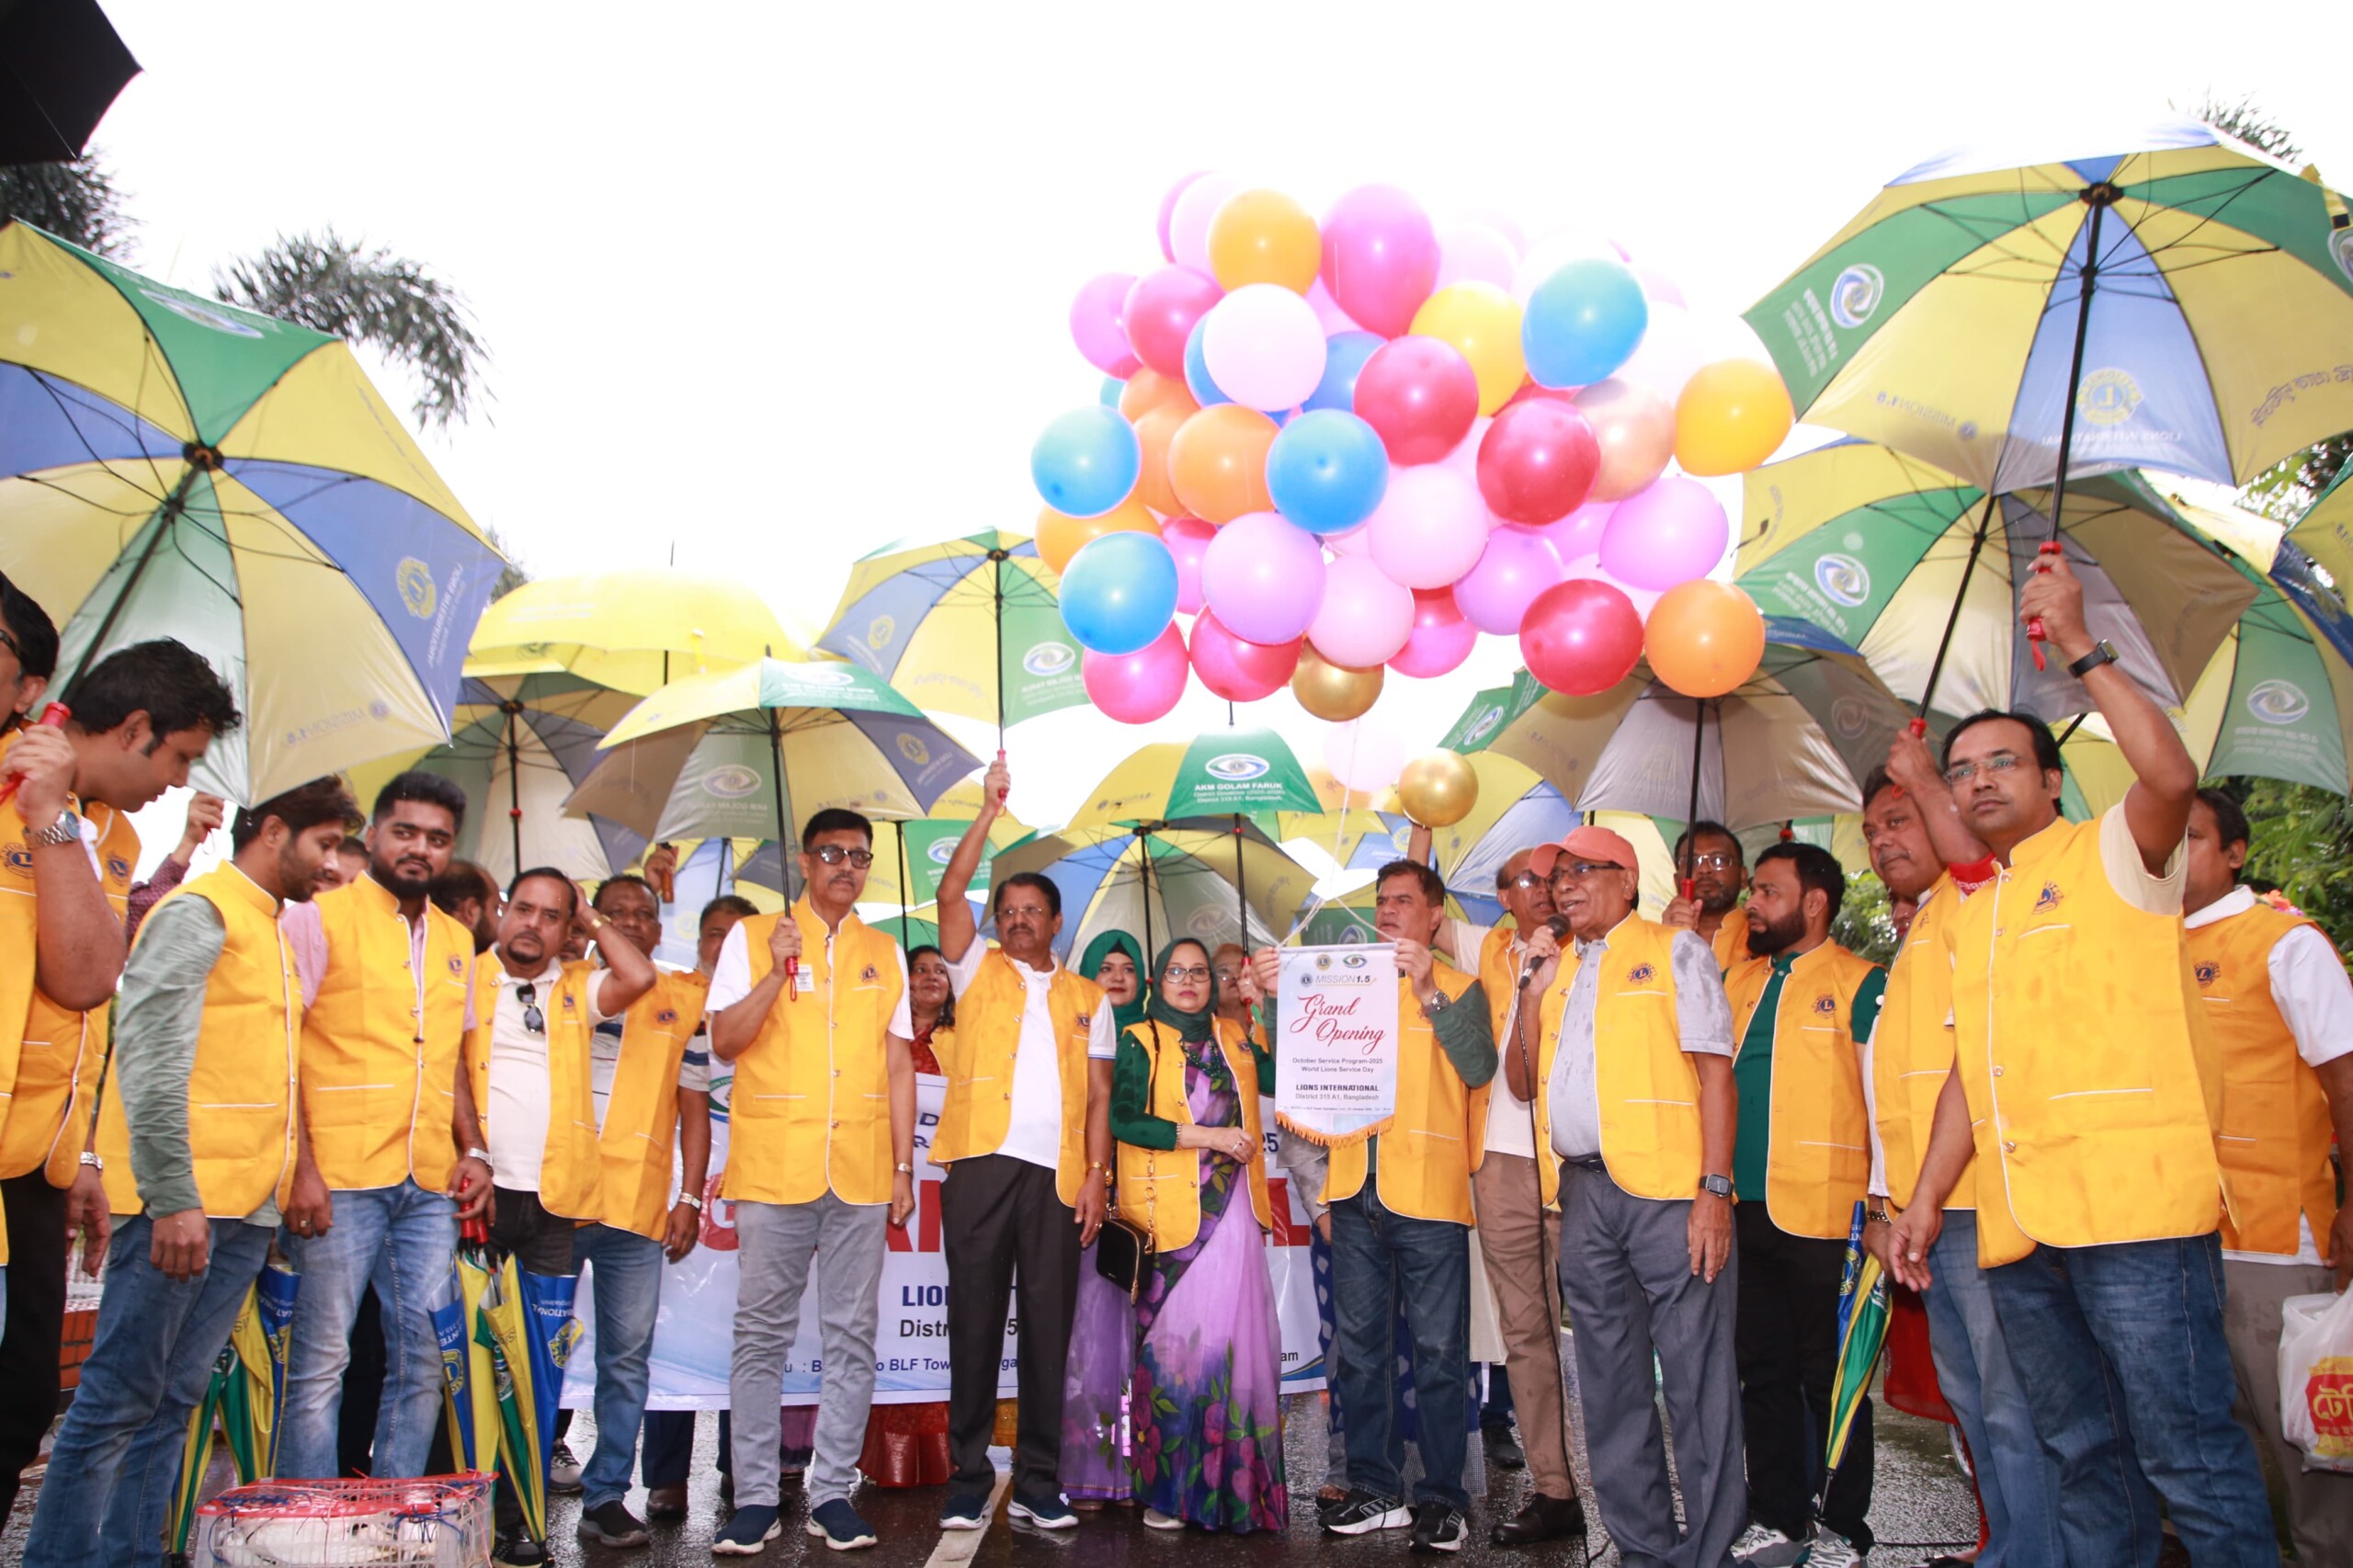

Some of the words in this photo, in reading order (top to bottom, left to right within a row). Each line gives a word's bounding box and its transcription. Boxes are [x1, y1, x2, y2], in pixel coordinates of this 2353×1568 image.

[1315, 975, 1356, 983] MISSION
[1356, 975, 1370, 983] 1.5
[1290, 994, 1360, 1033] Grand
[1315, 1017, 1386, 1055] Opening
[900, 1319, 949, 1337] Distr
[889, 1358, 919, 1371] BLF
[923, 1358, 951, 1370] Tow
